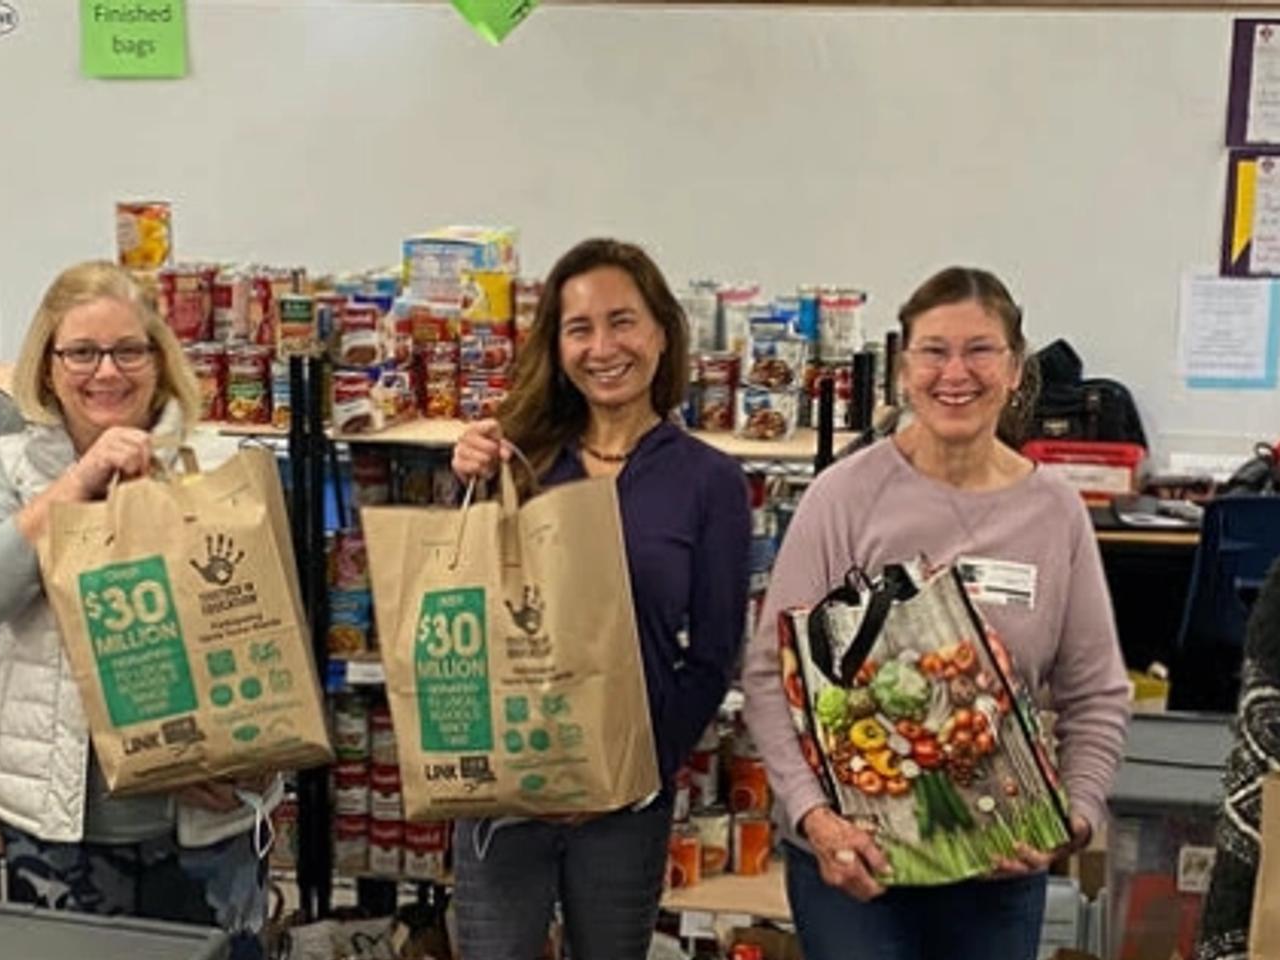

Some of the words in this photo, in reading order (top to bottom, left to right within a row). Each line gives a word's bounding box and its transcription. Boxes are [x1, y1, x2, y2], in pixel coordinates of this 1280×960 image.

[94, 5, 172, 22] Finished
[112, 35, 156, 58] bags
[85, 580, 167, 631] $30
[96, 621, 179, 655] MILLION
[417, 611, 481, 658] $30
